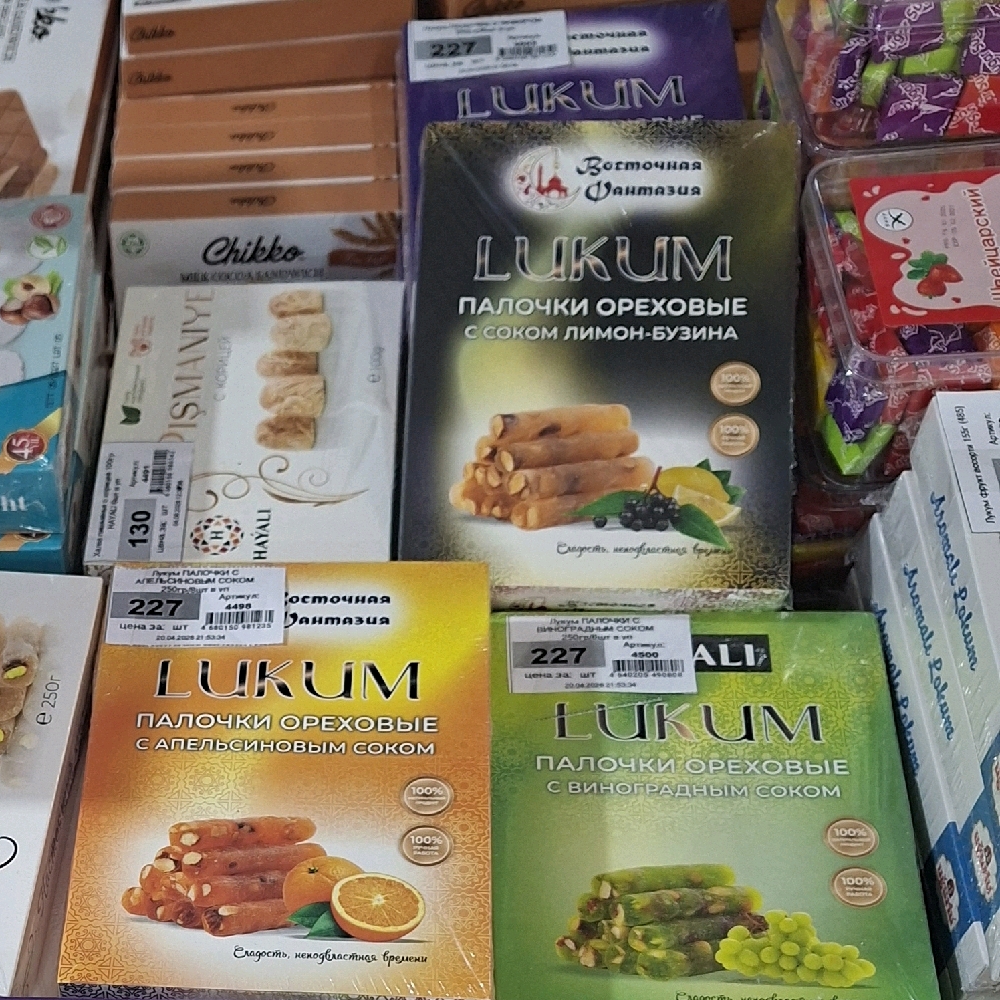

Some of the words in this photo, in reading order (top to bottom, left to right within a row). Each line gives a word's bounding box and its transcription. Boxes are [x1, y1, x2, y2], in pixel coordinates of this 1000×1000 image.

[430, 42, 477, 58] 227
[457, 75, 687, 120] LUKUM
[576, 156, 702, 176] Восточная
[584, 180, 701, 201] Фантазия
[202, 236, 304, 265] Chikko
[473, 235, 733, 282] LUKUM
[458, 297, 589, 317] ПАЛОЧКИ
[596, 297, 748, 316] ОРЕХОВЫЕ
[465, 325, 478, 340] С
[483, 325, 558, 340] СОКОМ
[564, 325, 738, 341] ЛИМОН-БУЗИНА
[128, 511, 151, 548] 130
[128, 599, 184, 617] 227
[531, 648, 587, 665] 227
[153, 659, 421, 701] LUKUM
[40, 674, 62, 709] 250г
[135, 713, 271, 732] ПАЛОЧКИ
[280, 714, 439, 733] ОРЕХОВЫЕ
[553, 701, 825, 743] LUKUM
[135, 737, 149, 751] С
[154, 737, 346, 755] АПЕЛЬСИНОВЫМ
[354, 741, 435, 756] СОКОМ
[535, 755, 676, 774] ПАЛОЧКИ
[685, 757, 850, 776] ОРЕХОВЫЕ
[411, 787, 444, 797] 100%
[546, 780, 561, 794] С
[568, 781, 749, 798] ВИНОГРАДНЫМ
[756, 784, 842, 798] СОКОМ
[410, 836, 443, 846] 100%
[835, 826, 868, 837] 100%
[841, 876, 875, 886] 100%
[234, 945, 290, 961] Сладость,
[294, 949, 378, 965] неподвластная
[383, 950, 429, 964] времени
